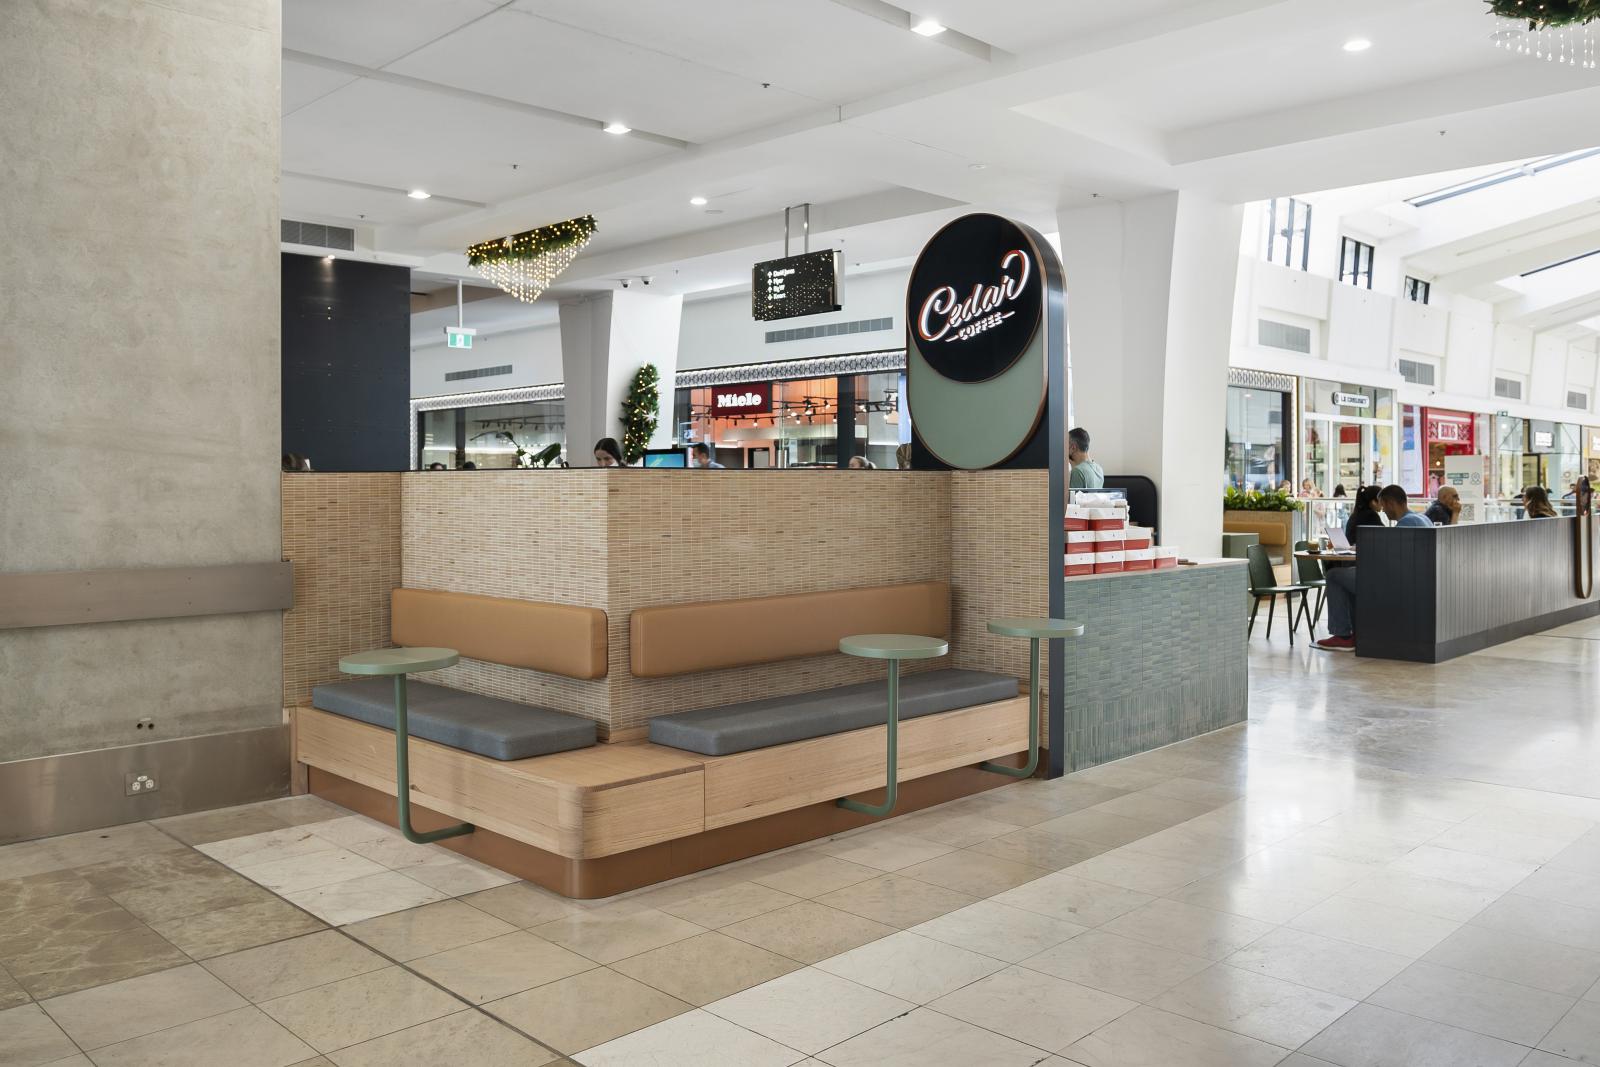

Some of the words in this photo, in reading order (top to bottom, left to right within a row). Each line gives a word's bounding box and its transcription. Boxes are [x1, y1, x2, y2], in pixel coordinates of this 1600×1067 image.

[918, 250, 1030, 341] Cedar
[958, 312, 1004, 341] COFFEE
[717, 392, 762, 408] Miele
